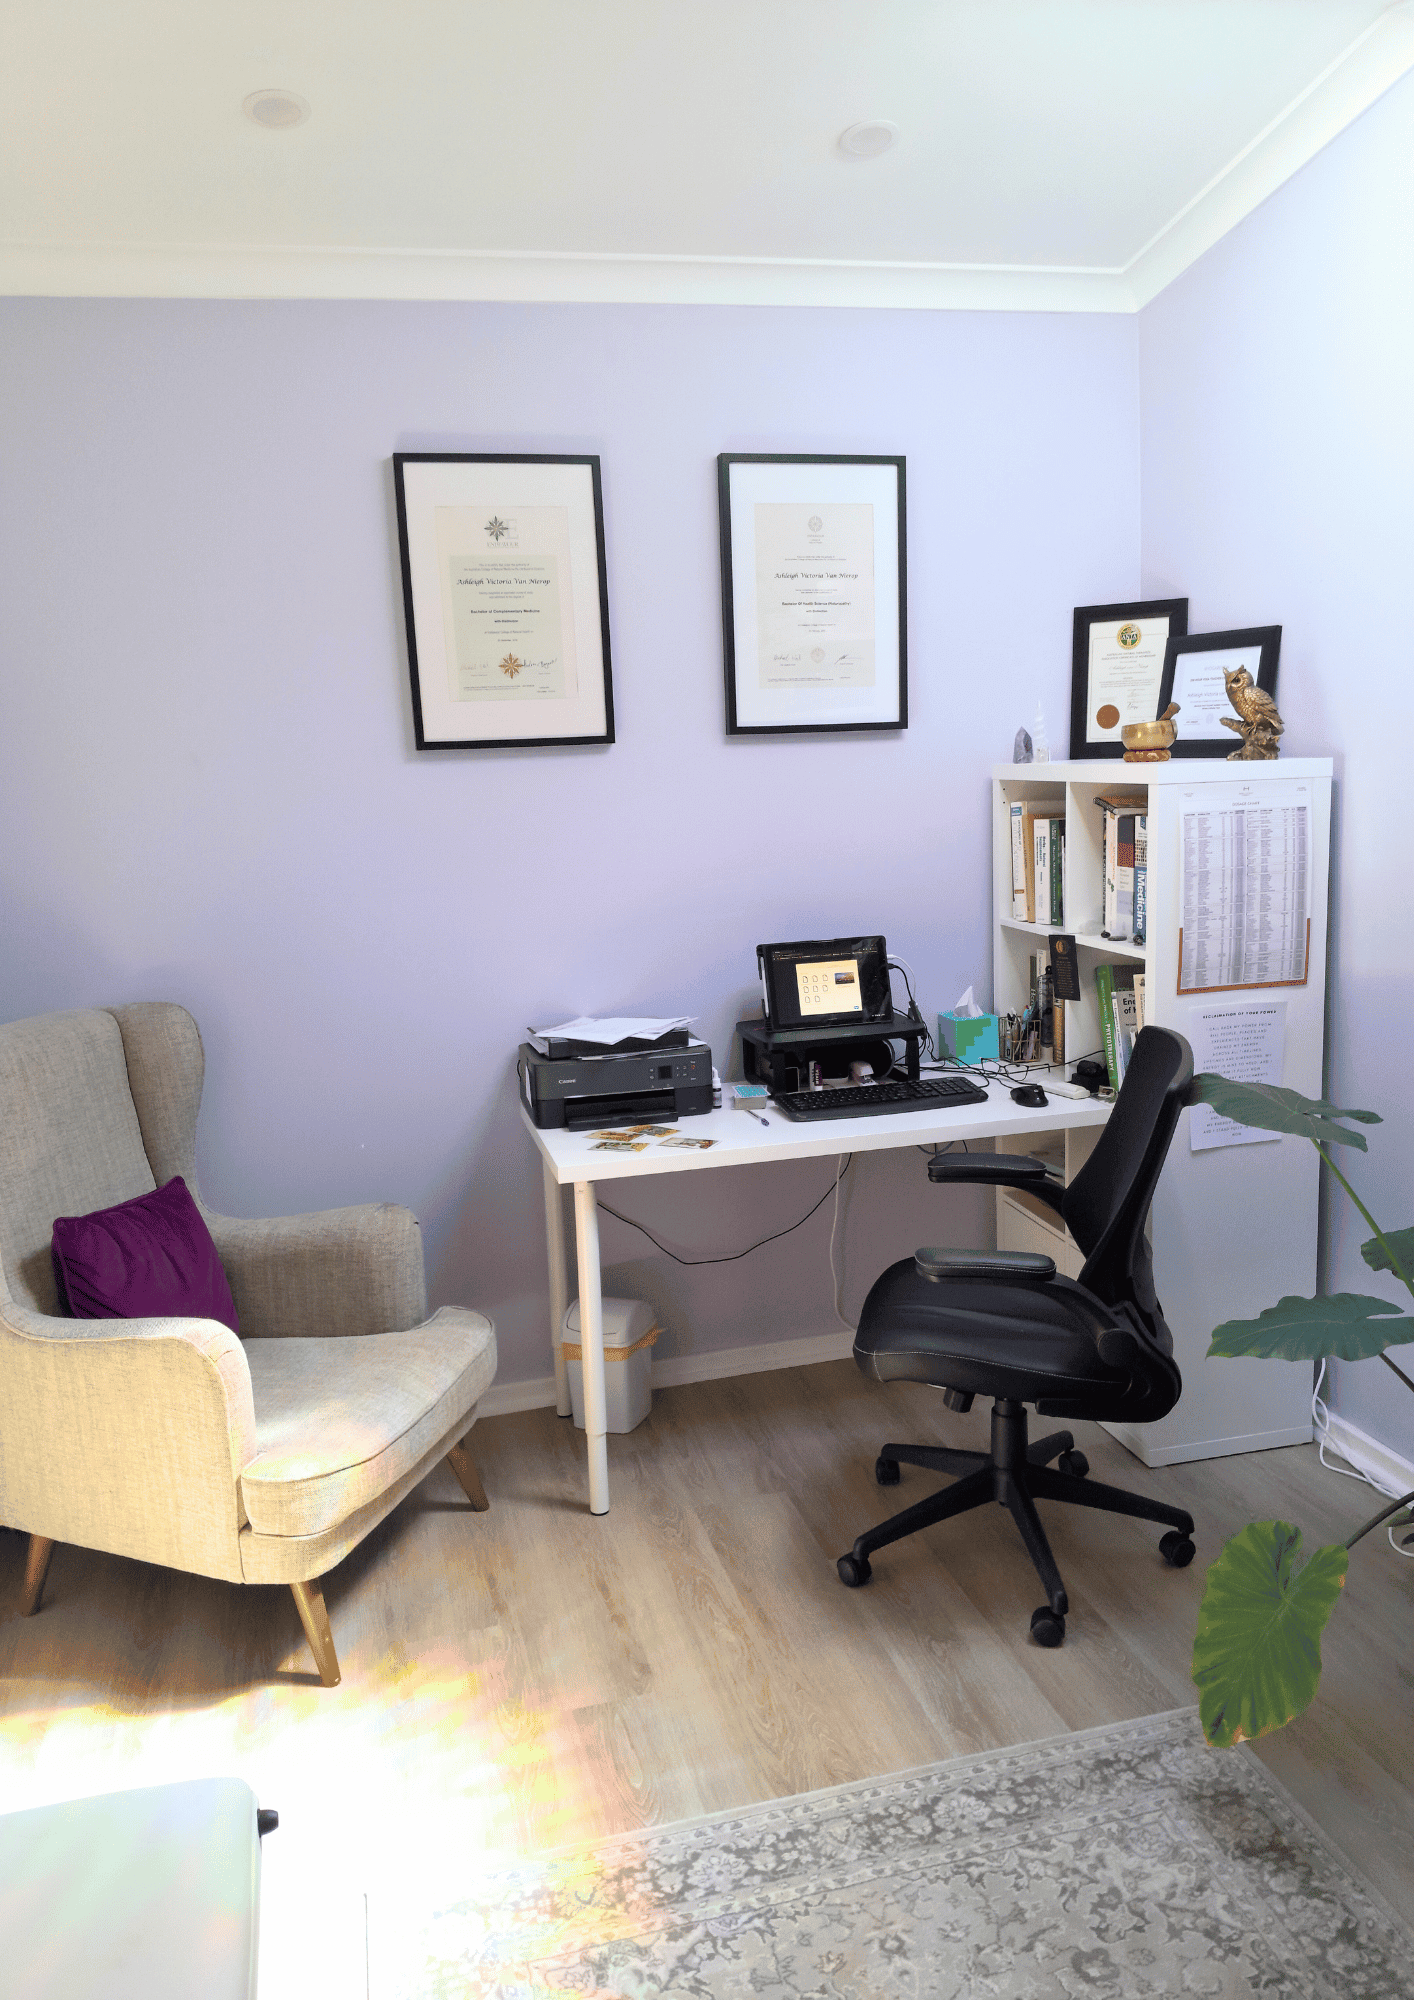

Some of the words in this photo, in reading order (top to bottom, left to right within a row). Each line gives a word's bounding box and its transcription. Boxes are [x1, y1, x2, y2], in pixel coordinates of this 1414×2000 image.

[457, 578, 484, 587] Ashleigh
[528, 578, 551, 587] Nierop
[1136, 875, 1145, 930] Medicine
[1105, 1023, 1115, 1071] PHYTOTHERAPY
